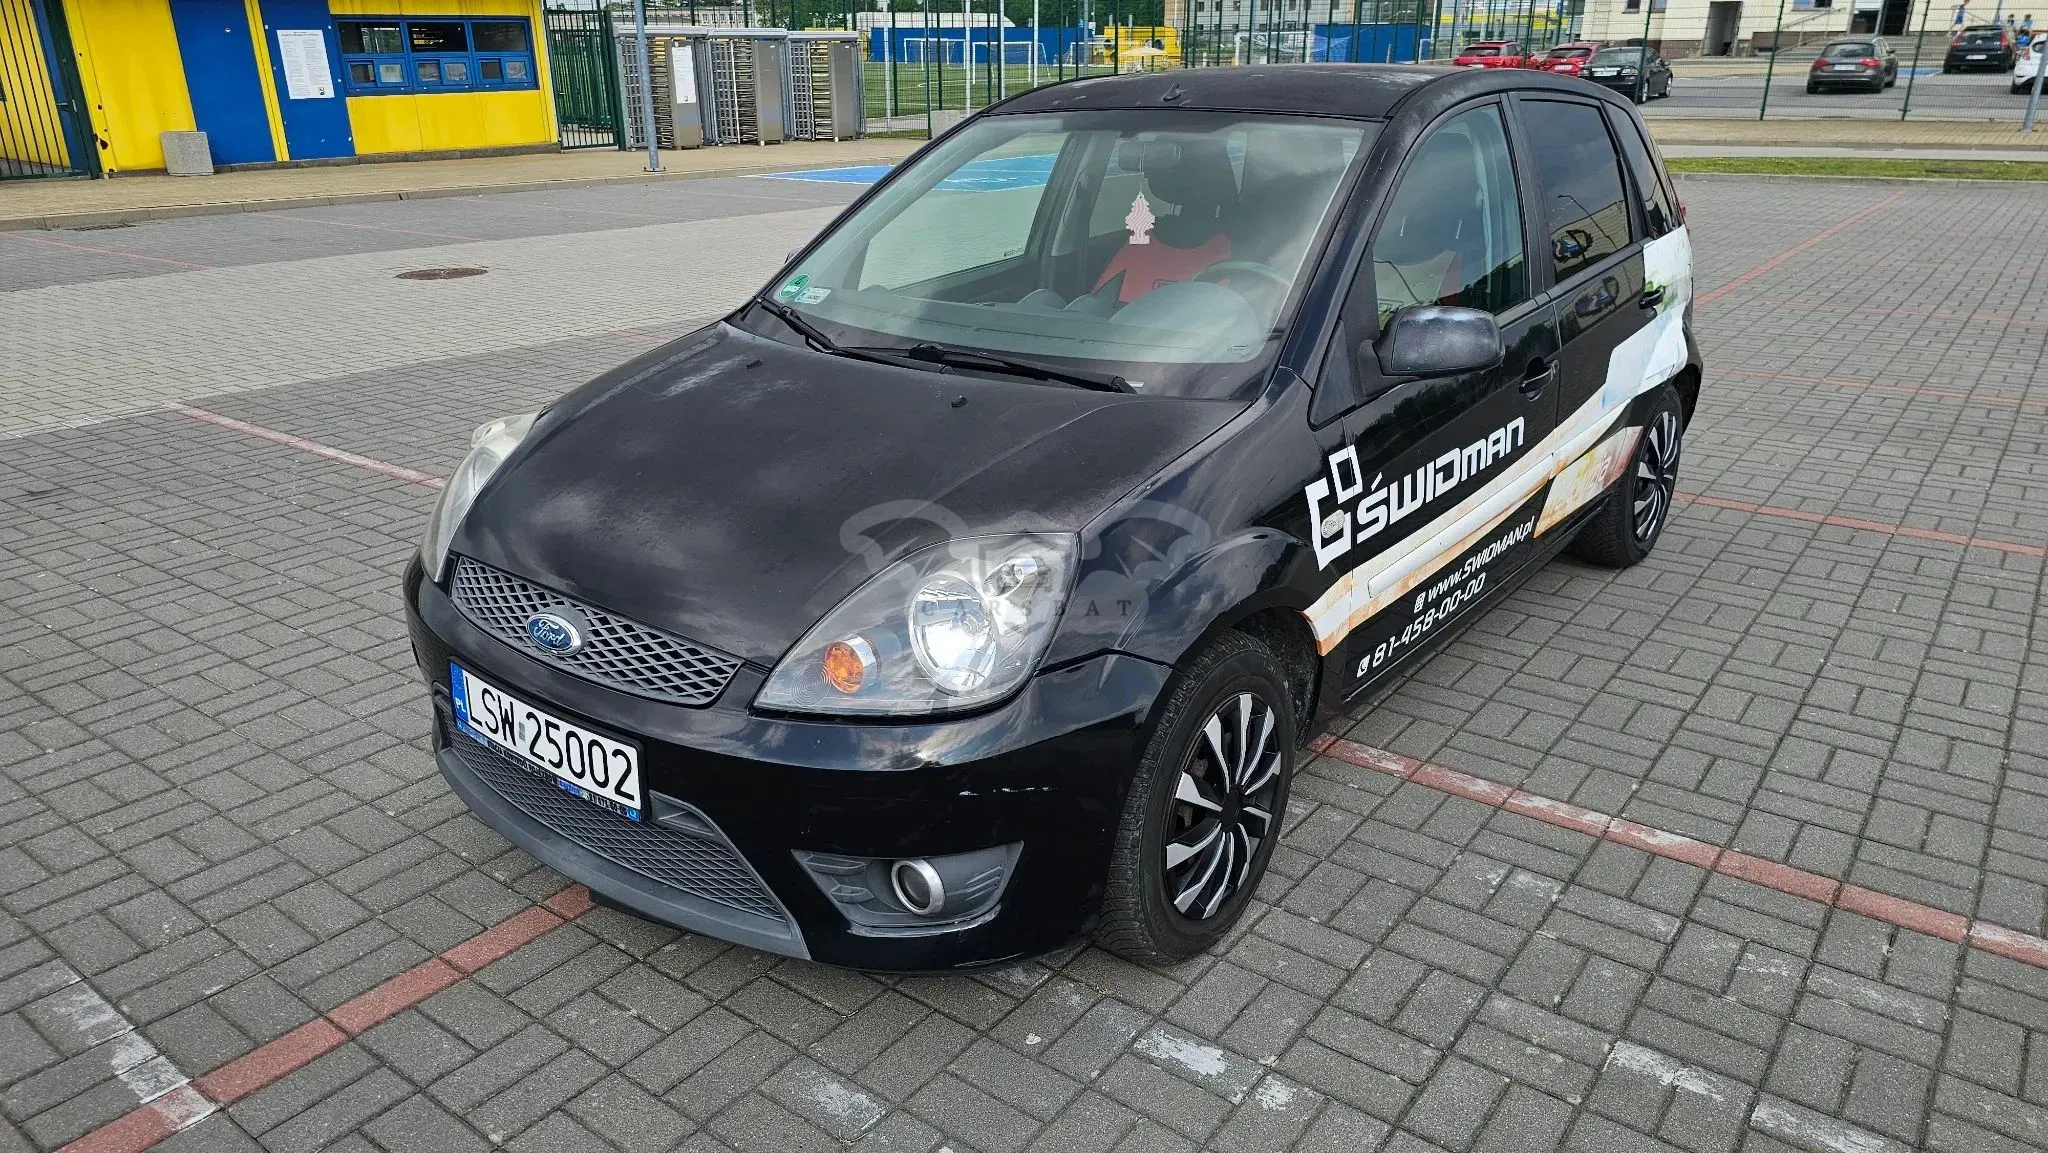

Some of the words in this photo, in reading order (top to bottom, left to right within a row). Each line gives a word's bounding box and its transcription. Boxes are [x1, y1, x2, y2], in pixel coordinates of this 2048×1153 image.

[534, 620, 565, 646] Ford
[1373, 572, 1486, 667] 81-458-00-00
[455, 697, 467, 713] PL
[465, 676, 516, 746] LSW
[526, 711, 635, 801] 25002
